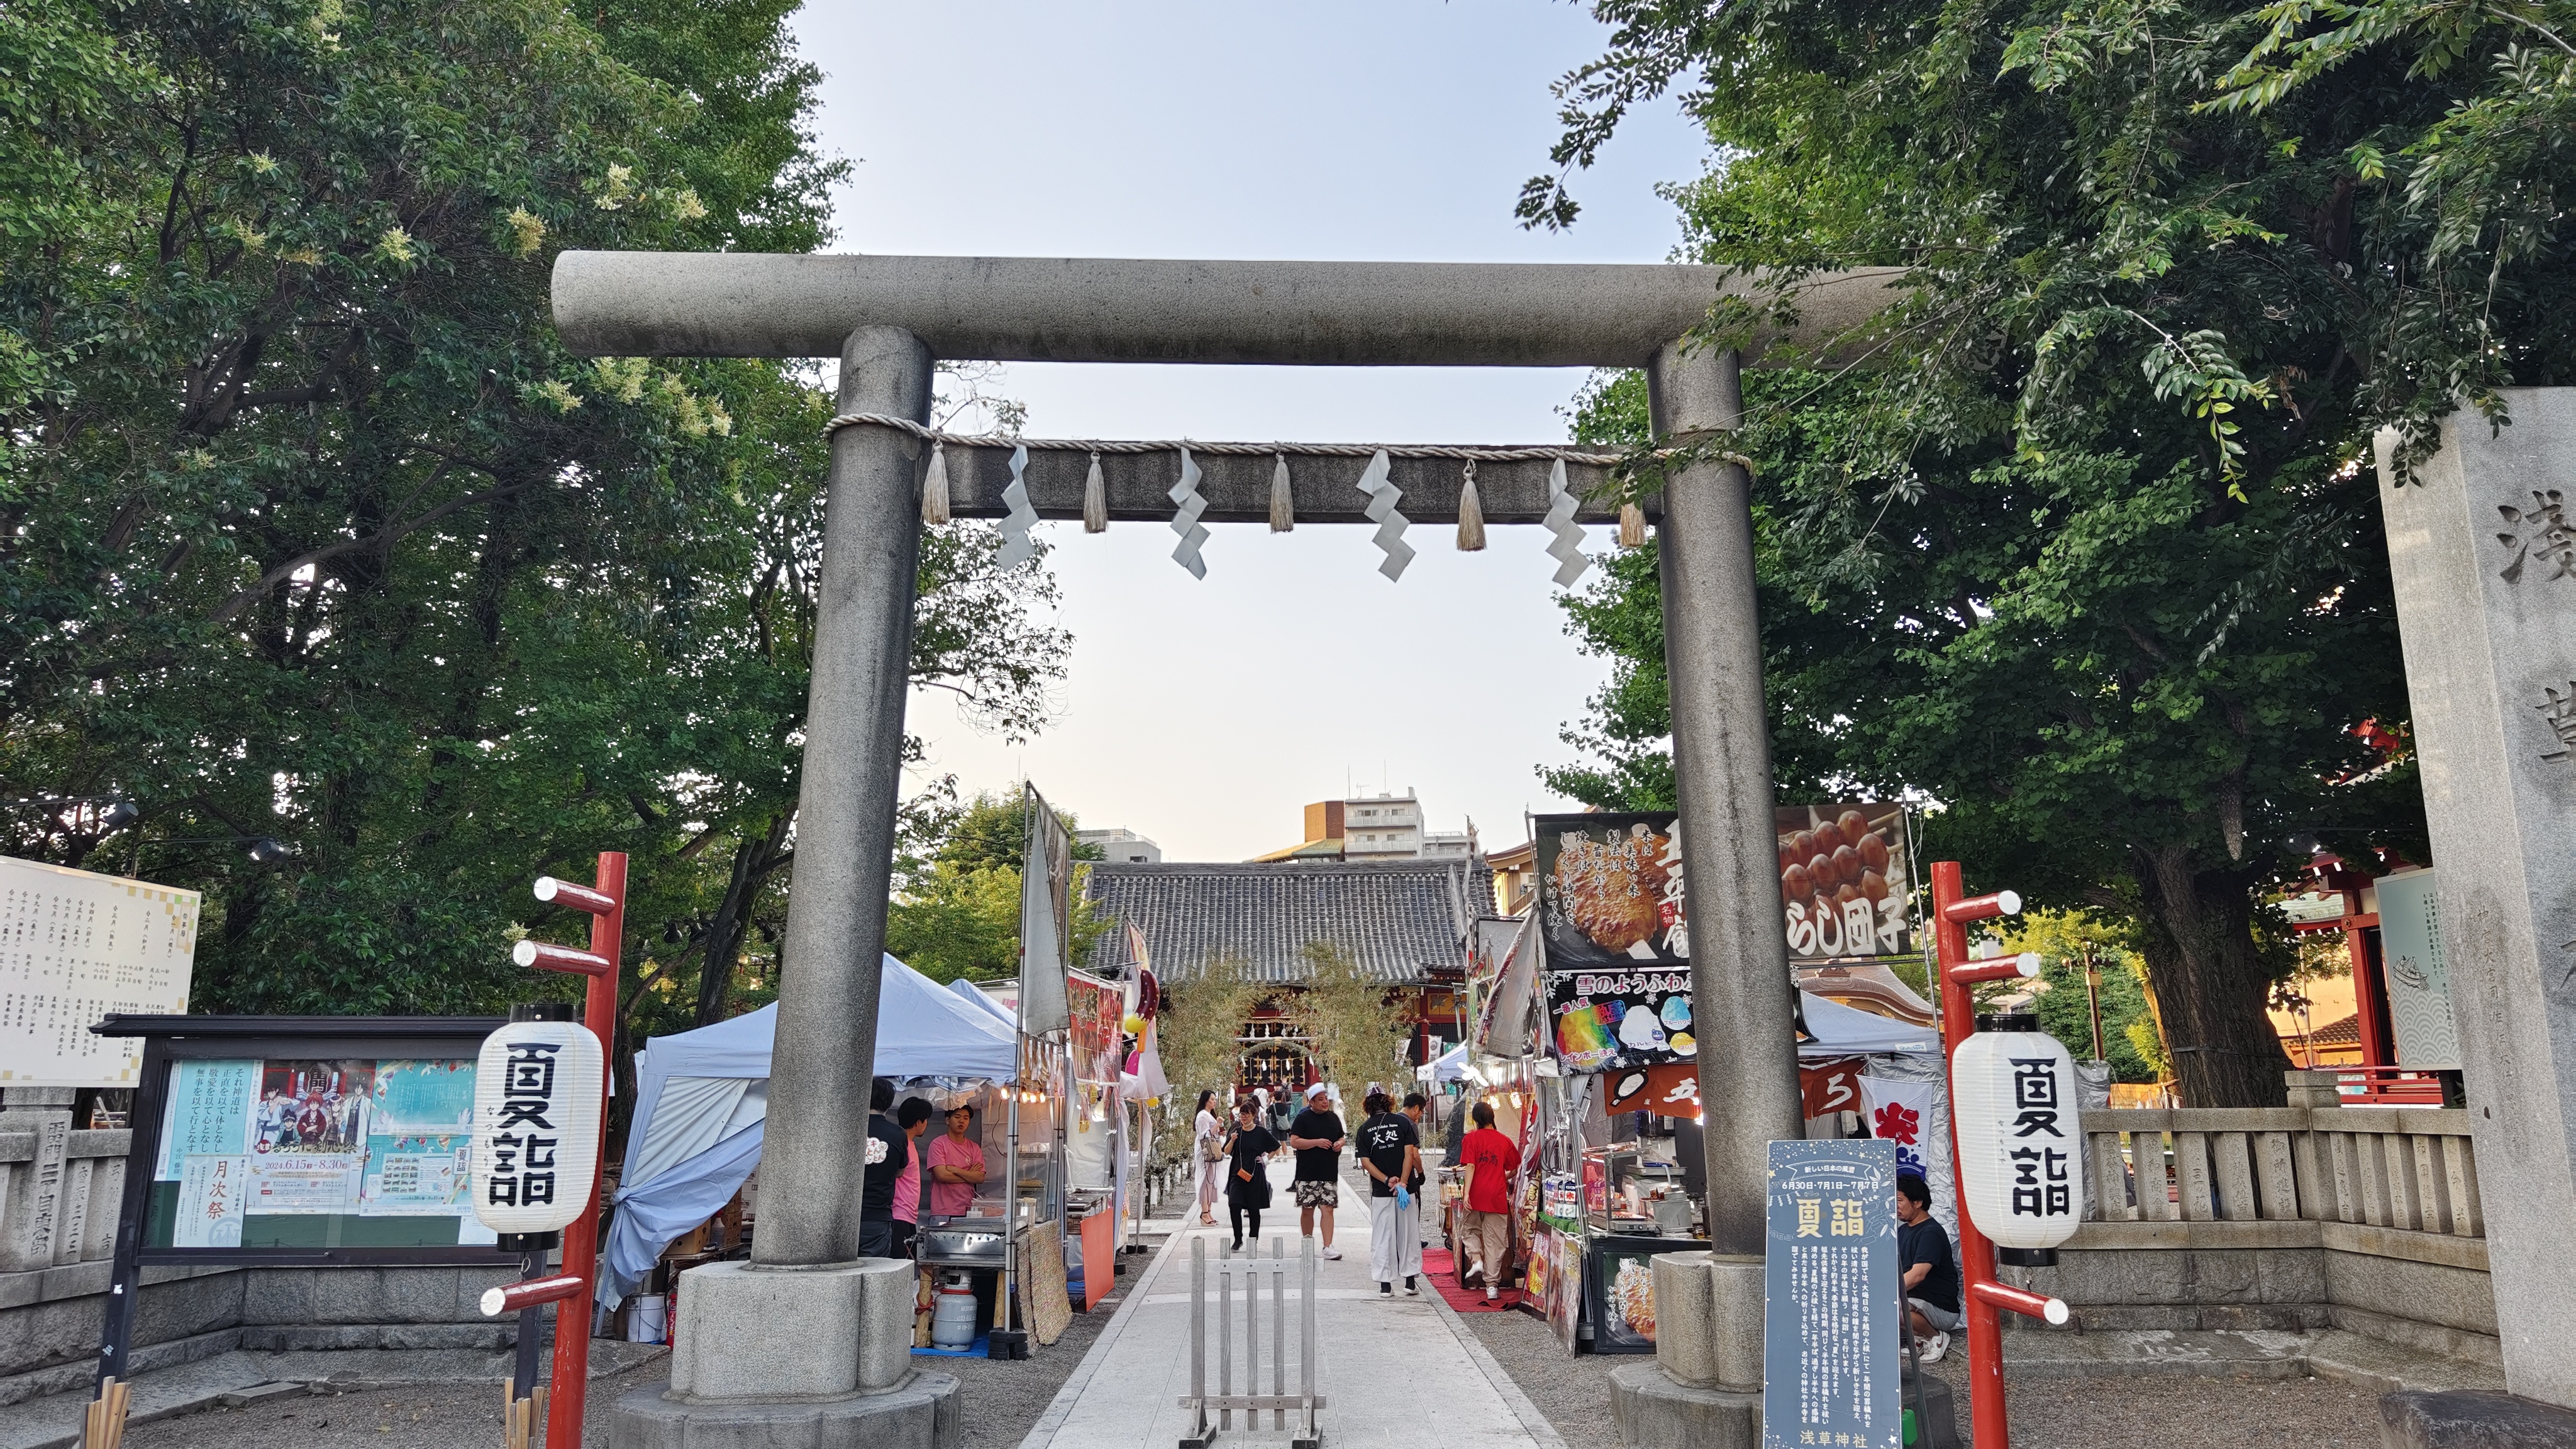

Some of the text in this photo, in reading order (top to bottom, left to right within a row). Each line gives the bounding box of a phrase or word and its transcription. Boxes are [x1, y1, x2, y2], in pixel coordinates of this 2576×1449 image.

[1575, 830, 1590, 871] 焼きは
[1606, 829, 1621, 871] 製法は
[1641, 829, 1653, 856] 米は
[1561, 831, 1577, 925] じっくり時間を
[1592, 845, 1606, 900] 昔ながら
[1624, 843, 1640, 899] 美味い米
[1545, 873, 1563, 941] かけて焼く
[1661, 904, 1674, 924] 名物
[1786, 896, 1907, 956] らし団子
[1553, 996, 1590, 1015] 一番人気
[1558, 1048, 1618, 1062] レインボー映え
[186, 1067, 205, 1153] 無事を以て行となす
[200, 1067, 219, 1153] 敬愛を以て心となし
[213, 1068, 231, 1153] 正直を以て体となし
[229, 1068, 245, 1115] それ神道は
[1663, 1077, 1699, 1104] 五
[489, 1042, 564, 1207] 夏詣
[1997, 1119, 2006, 1164] なつもうで
[2007, 1057, 2069, 1218] 夏詣
[273, 1140, 358, 1155] るろうに剣心祭
[457, 1149, 467, 1172] 夏詣
[206, 1160, 228, 1220] 月次祭
[1796, 1198, 1864, 1238] 夏詣
[1607, 1285, 1618, 1331] かけて焼く
[1639, 1267, 1648, 1306] 昔ながら
[1799, 1429, 1868, 1448] 浅草神社
